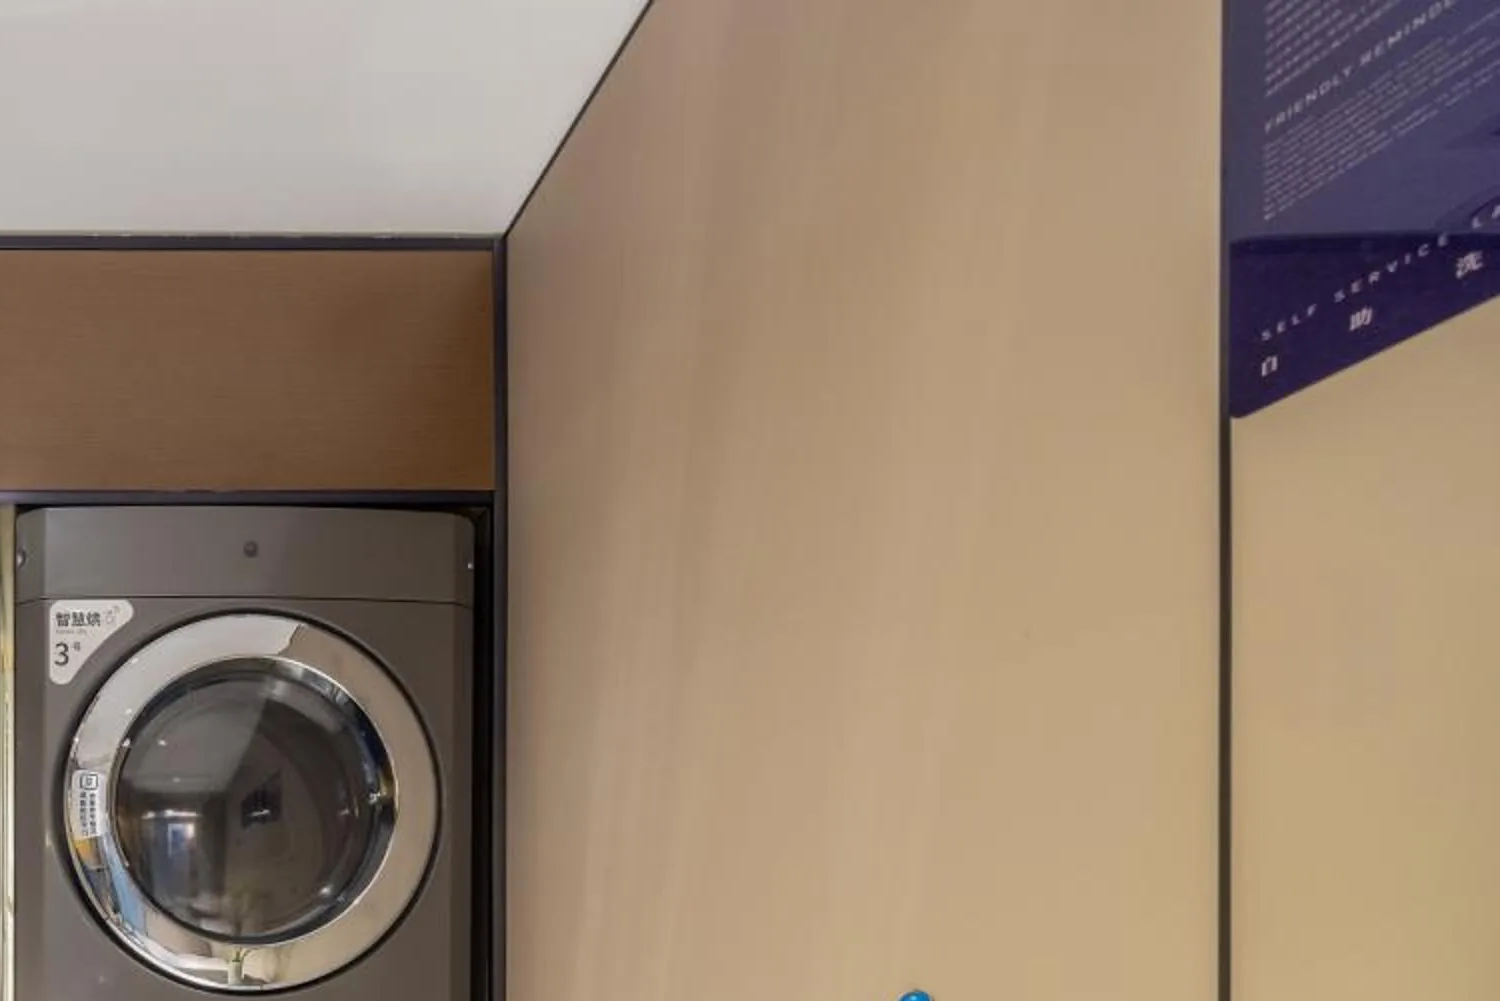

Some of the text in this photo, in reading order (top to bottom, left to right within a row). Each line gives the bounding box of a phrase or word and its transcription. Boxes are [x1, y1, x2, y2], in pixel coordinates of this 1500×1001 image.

[1263, 65, 1354, 135] FRIENDLY
[1260, 303, 1318, 342] SELF
[1333, 232, 1449, 303] SERVICE
